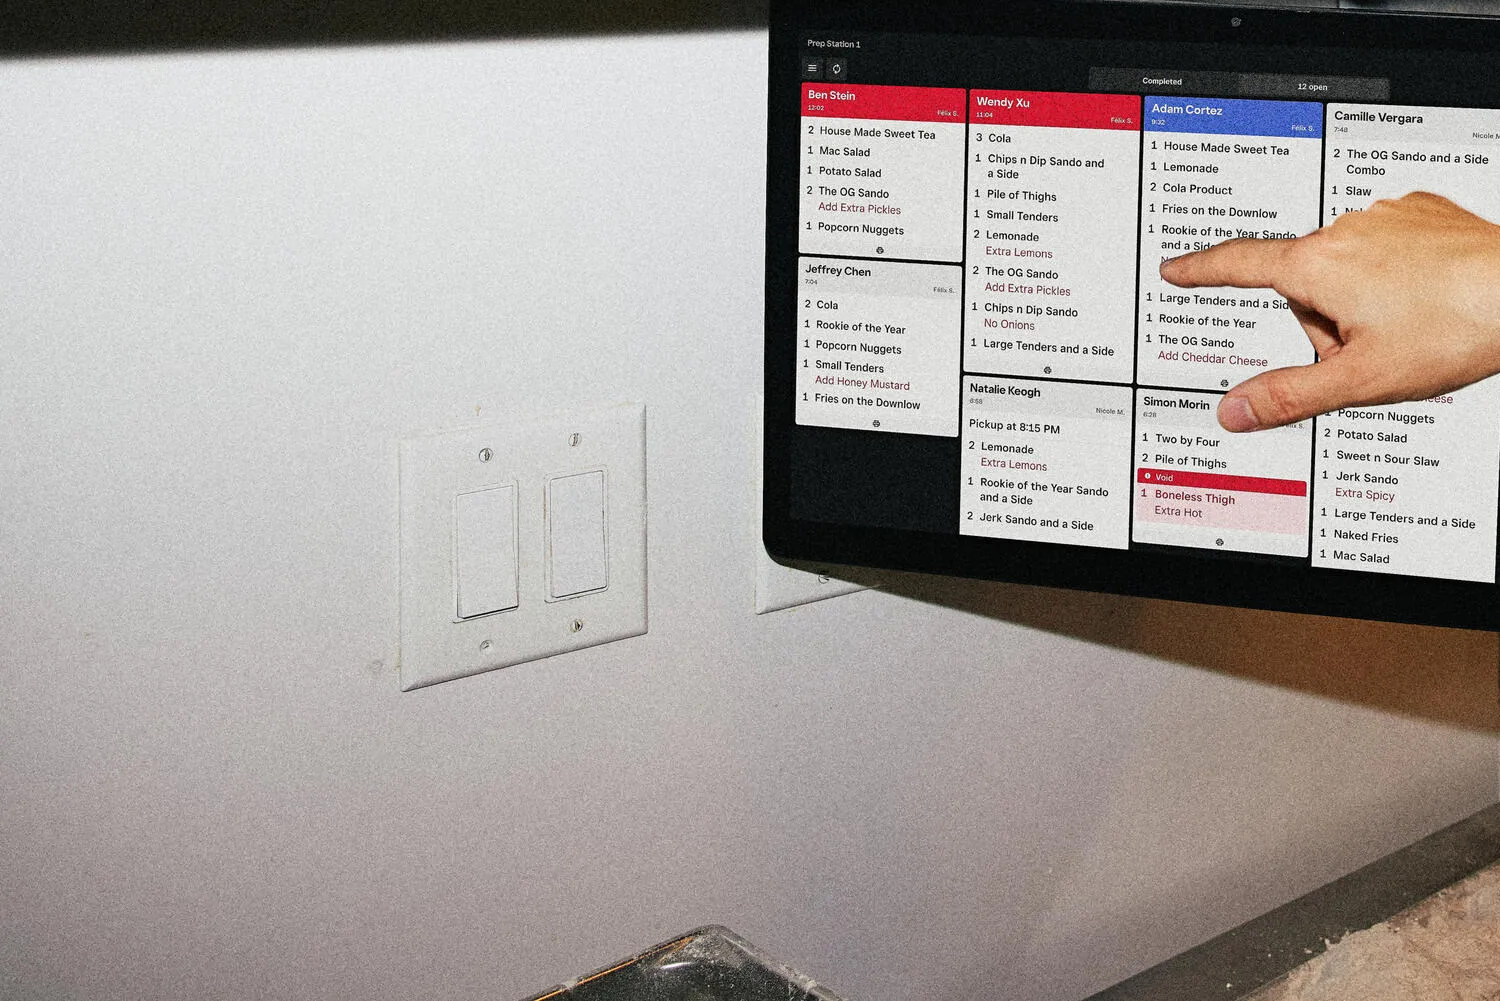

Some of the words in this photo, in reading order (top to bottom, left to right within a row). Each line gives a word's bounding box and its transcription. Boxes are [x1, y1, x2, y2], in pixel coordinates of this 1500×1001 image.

[806, 38, 825, 48] Prep
[826, 39, 855, 48] Station
[855, 40, 860, 48] 1
[1141, 76, 1182, 85] Completed
[1297, 82, 1307, 90] 12
[1307, 84, 1328, 92] open
[807, 89, 828, 100] Ben
[829, 90, 856, 100] Stein
[976, 96, 1014, 109] Wendy
[1015, 97, 1030, 108] Xu
[1151, 102, 1183, 114] Adam
[1184, 104, 1222, 115] Cortez
[1333, 109, 1376, 122] Camille
[1377, 111, 1423, 125] Vergara
[807, 124, 814, 134] 2
[819, 125, 851, 136] House
[853, 126, 881, 137] Made
[883, 128, 915, 139] Sweet
[917, 129, 936, 140] Tea
[987, 132, 1011, 143] Cola
[807, 144, 813, 154] 1
[819, 145, 840, 156] Mac
[842, 146, 870, 157] Salad
[987, 152, 1017, 165] Chips
[1019, 156, 1026, 164] n
[1029, 154, 1047, 167] Dip
[1049, 156, 1082, 167] Sando
[1084, 158, 1104, 168] and
[806, 164, 812, 174] 1
[818, 165, 852, 176] Potato
[854, 166, 882, 178] Salad
[986, 169, 994, 178] a
[996, 168, 1019, 179] Side
[1345, 163, 1386, 176] Combo
[806, 184, 813, 195] 2
[817, 185, 837, 196] The
[839, 186, 855, 197] OG
[857, 187, 889, 199] Sando
[986, 188, 1006, 199] Pile
[1007, 189, 1020, 200] of
[1021, 190, 1057, 203] Thighs
[1162, 182, 1186, 193] Cola
[1188, 183, 1232, 195] Product
[1345, 185, 1372, 196] Slaw
[817, 201, 838, 212] Add
[839, 202, 865, 213] Extra
[867, 203, 901, 215] Pickles
[1161, 203, 1188, 214] Fries
[1190, 206, 1205, 215] on
[1207, 205, 1226, 216] the
[1228, 206, 1277, 219] Downlow
[805, 220, 812, 230] 1
[817, 220, 859, 233] Popcorn
[861, 223, 904, 236] Nuggets
[985, 229, 1039, 242] Lemonade
[985, 245, 1011, 256] Extra
[1013, 246, 1053, 259] Lemons
[804, 263, 842, 277] Jeffrey
[843, 265, 871, 276] Chen
[815, 319, 849, 331] Rookie
[851, 321, 862, 331] of
[864, 322, 882, 333] the
[883, 323, 906, 334] Year
[1157, 349, 1179, 361] Add
[1181, 351, 1226, 364] Cheddar
[1228, 354, 1268, 367] Cheese
[814, 374, 834, 385] Add
[836, 376, 868, 389] Honey
[869, 378, 910, 391] Mustard
[969, 382, 1006, 395] Natalie
[1007, 385, 1041, 399] Keogh
[1143, 395, 1177, 408] Simon
[1178, 398, 1210, 410] Morin
[968, 417, 1004, 431] Pickup
[1005, 422, 1016, 431] at
[1018, 421, 1041, 433] 8:15
[1043, 423, 1060, 434] PM
[1155, 432, 1177, 444] Two
[1179, 434, 1193, 447] by
[1195, 435, 1220, 447] Four
[1336, 449, 1370, 462] Sweet
[1373, 454, 1381, 462] n
[1383, 452, 1410, 464] Sour
[1413, 455, 1440, 467] Slaw
[1154, 472, 1173, 482] Void
[1154, 488, 1202, 502] Boneless
[1204, 492, 1235, 506] Thigh
[1334, 486, 1363, 498] Extra
[1365, 488, 1395, 503] Spicy
[1154, 504, 1181, 516] Extra
[1183, 507, 1202, 518] Hot
[1333, 528, 1368, 541] Naked
[1370, 531, 1398, 544] Fries
